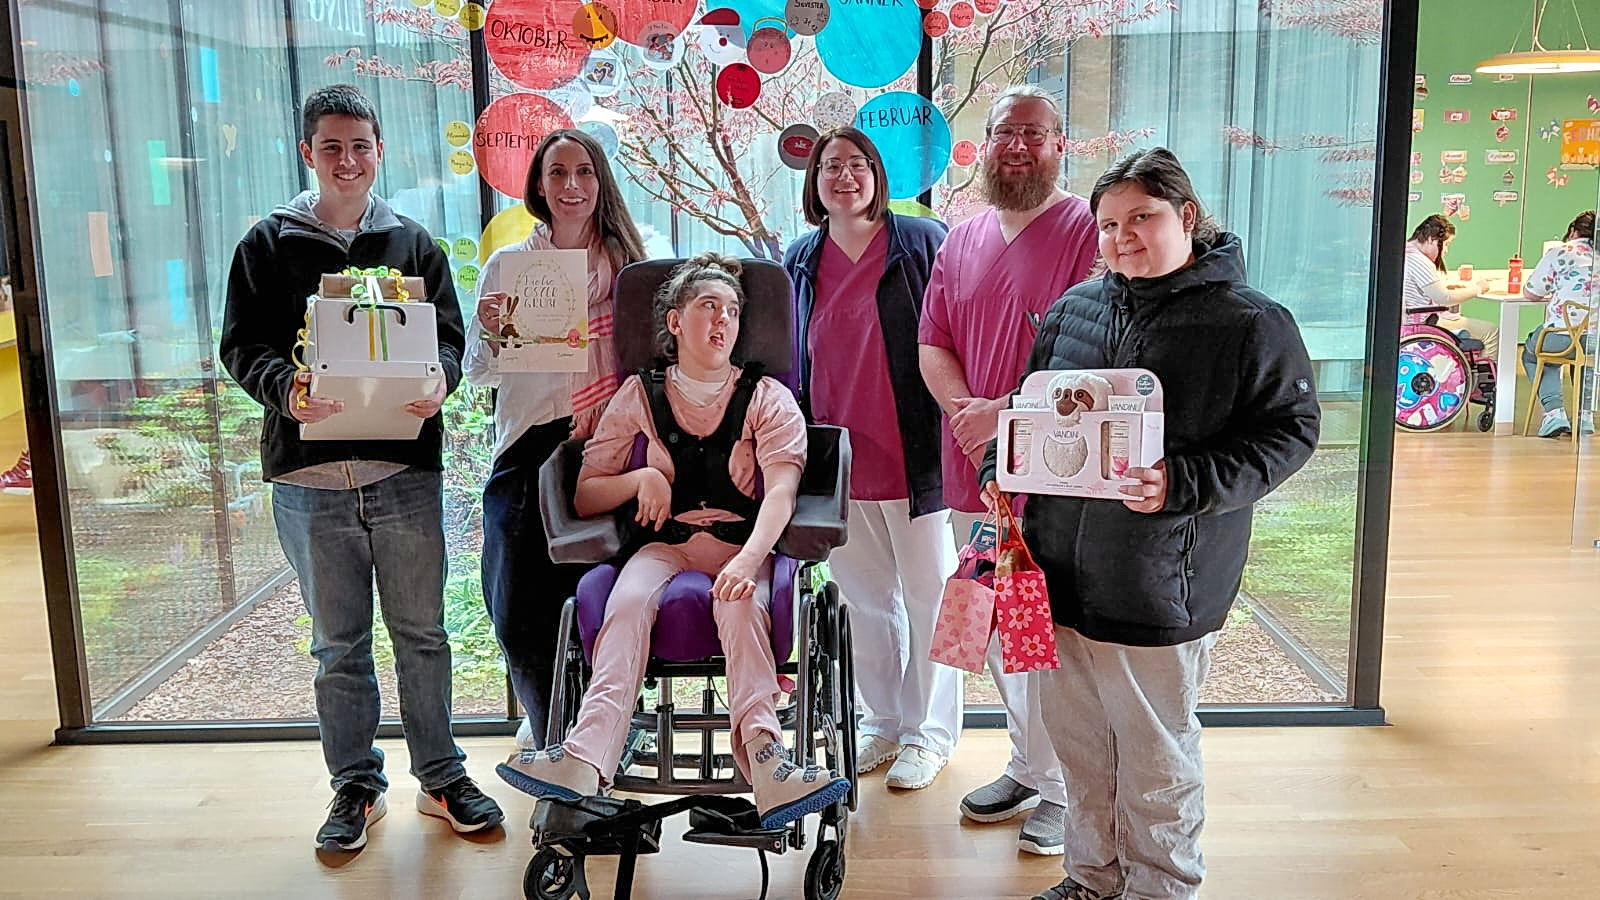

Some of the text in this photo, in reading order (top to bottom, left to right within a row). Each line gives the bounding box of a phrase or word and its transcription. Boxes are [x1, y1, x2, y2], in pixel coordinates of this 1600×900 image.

[491, 19, 568, 52] OKTOBER
[859, 105, 933, 129] FEBRUAR
[476, 129, 543, 151] SEPTEMB
[1053, 430, 1080, 439] VANDINI
